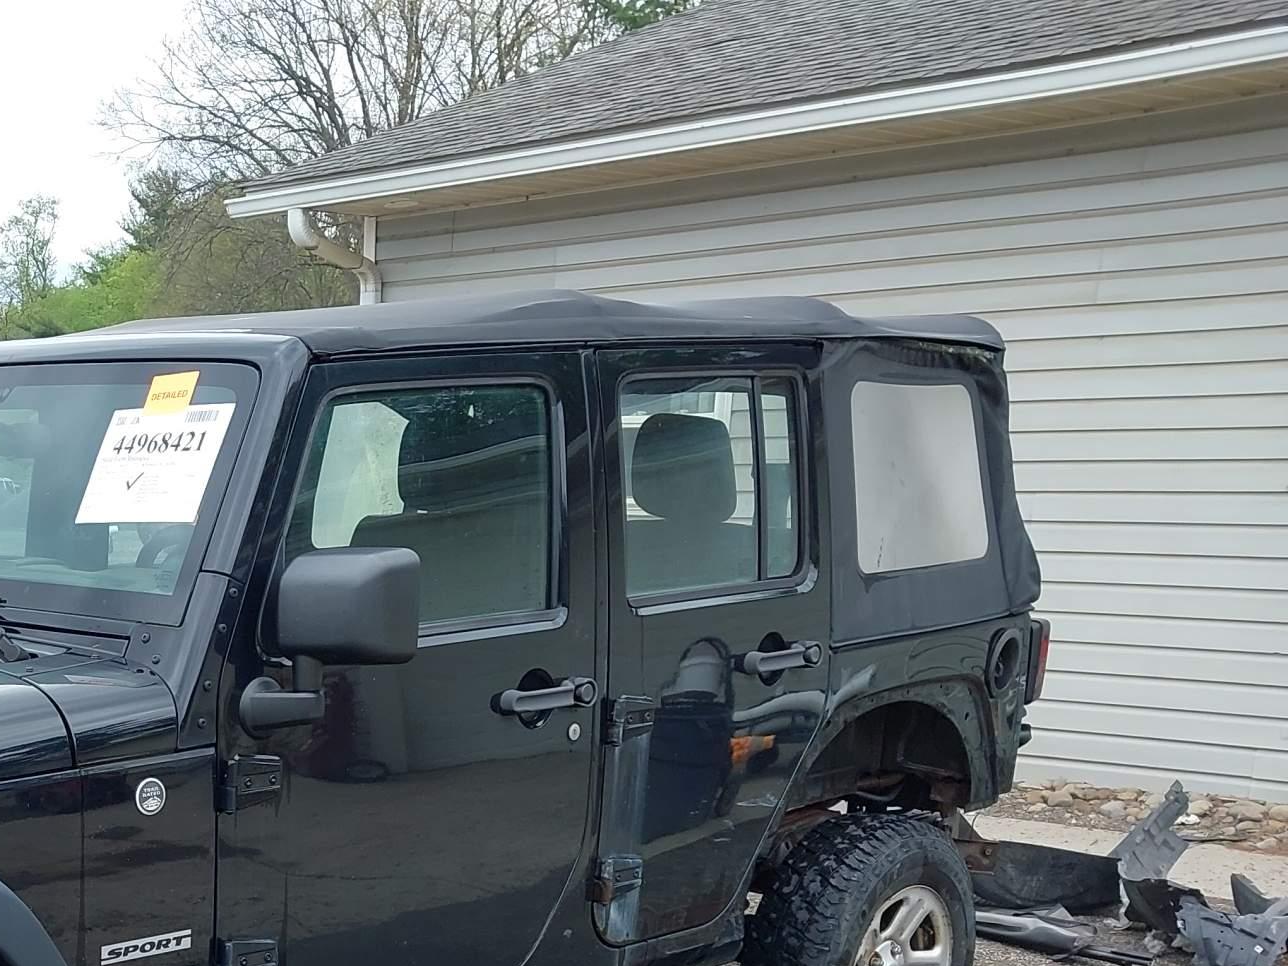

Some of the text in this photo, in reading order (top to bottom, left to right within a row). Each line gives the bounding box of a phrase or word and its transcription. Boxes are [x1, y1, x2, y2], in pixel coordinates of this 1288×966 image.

[151, 389, 189, 401] DETAILED
[112, 430, 208, 455] 44968421
[103, 934, 190, 960] SPORT
